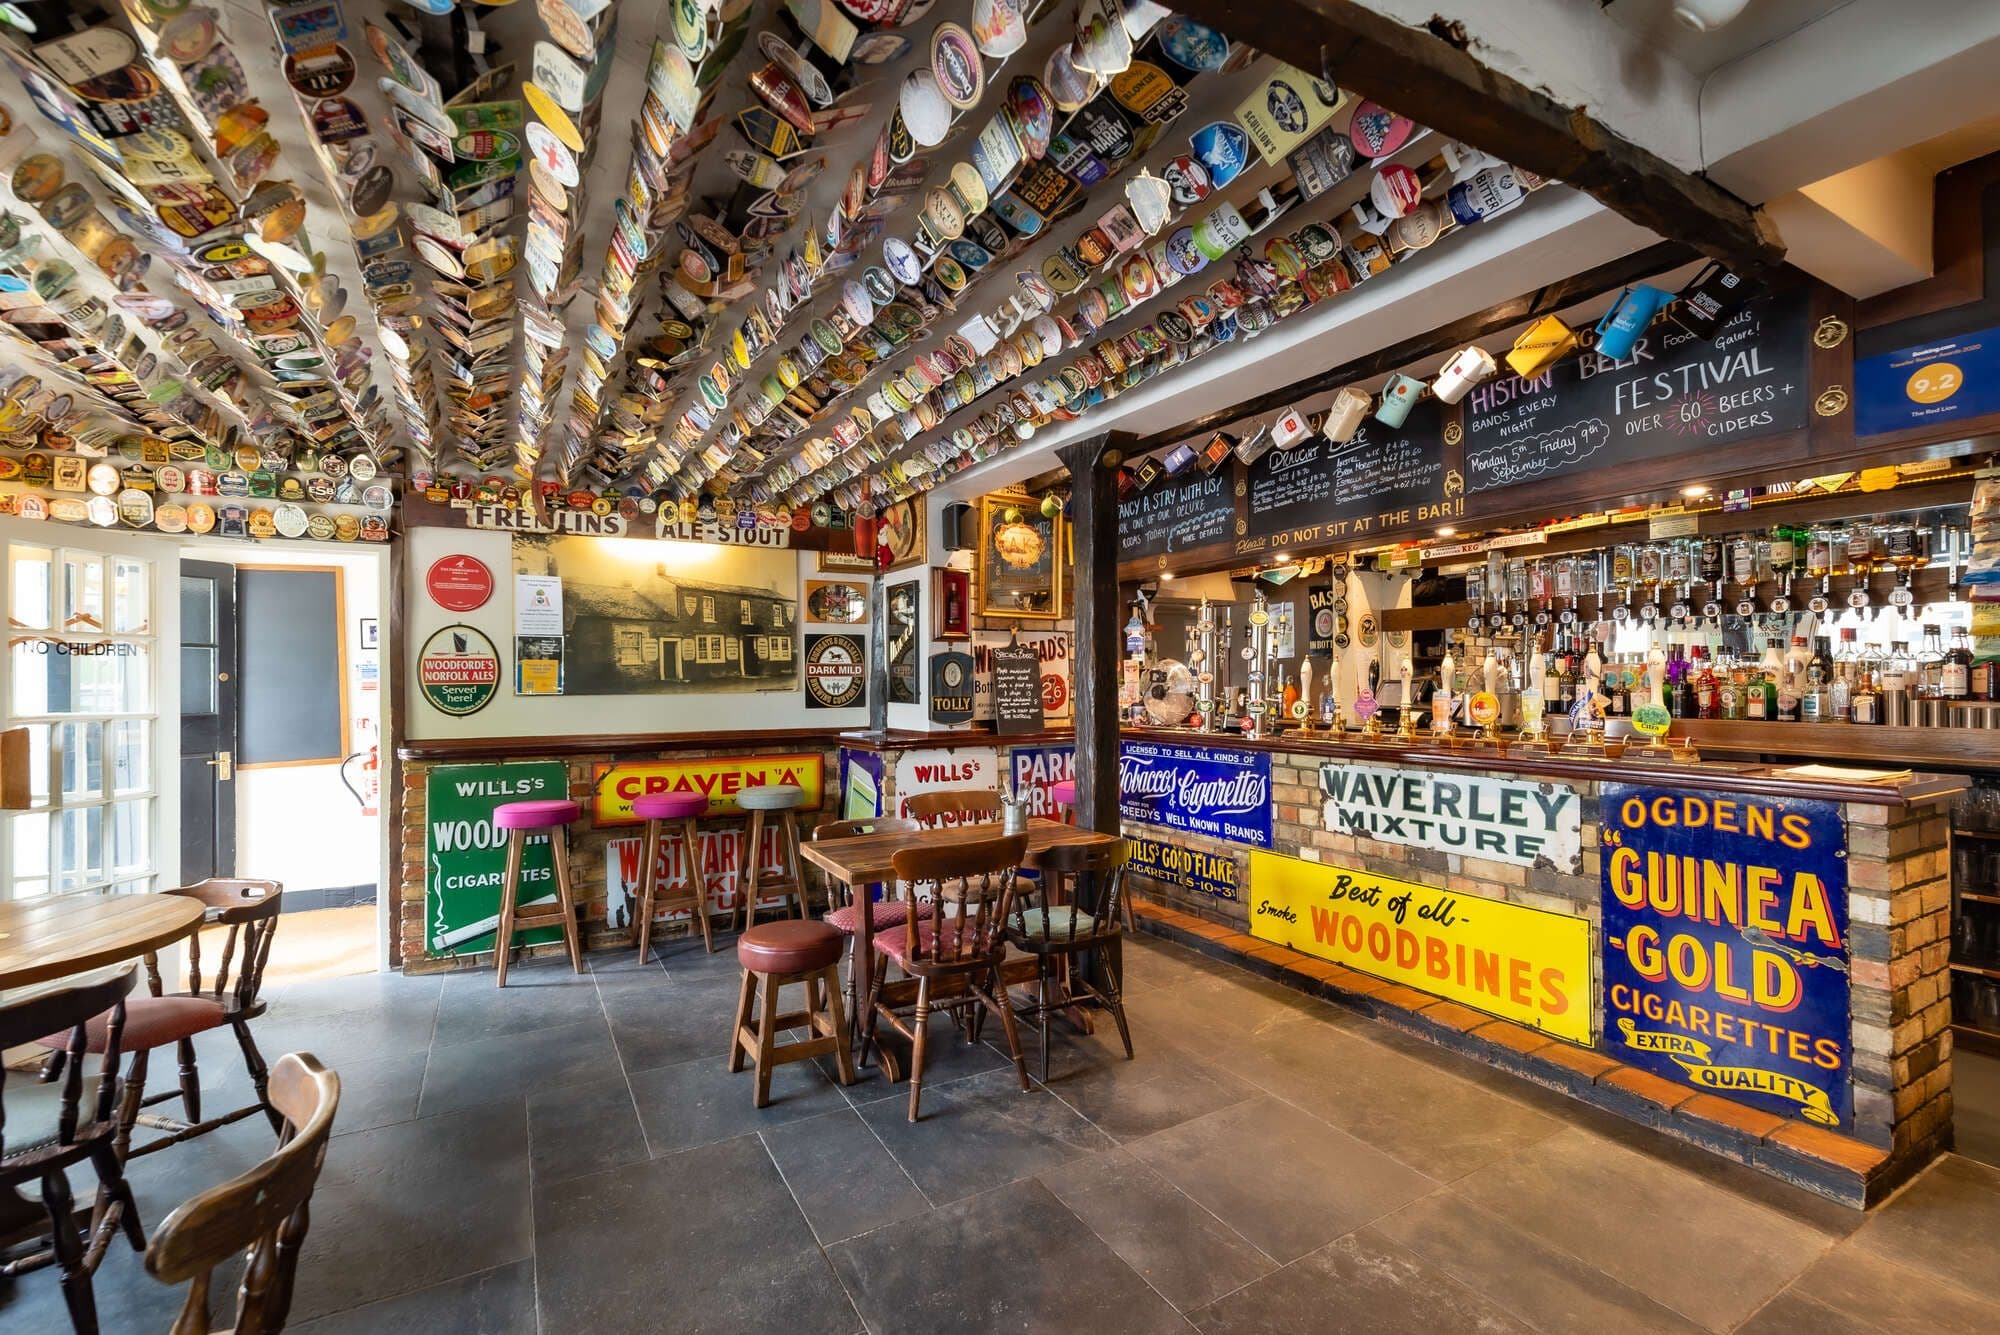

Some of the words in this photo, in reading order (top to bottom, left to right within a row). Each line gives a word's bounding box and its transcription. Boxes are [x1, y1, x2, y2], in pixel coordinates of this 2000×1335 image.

[309, 72, 341, 88] IPA
[1123, 71, 1158, 100] BLONDE
[1146, 90, 1184, 120] CLARK'S
[1091, 119, 1112, 136] BLACK
[1091, 119, 1128, 154] HARRY
[1244, 110, 1277, 155] SCULLION'S
[1025, 167, 1058, 202] BEER
[1295, 152, 1319, 192] MILD
[1476, 173, 1499, 211] BITTER
[1209, 211, 1224, 235] PALE
[1220, 233, 1237, 247] ALE
[1084, 234, 1107, 260] BEST
[1715, 321, 1761, 350] Galore!
[1100, 348, 1118, 375] ENIGMA
[1471, 370, 1552, 415] HISTON
[1579, 337, 1655, 382] BEER
[1615, 347, 1775, 416] FESTIVAL
[1914, 373, 1955, 394] 9.2
[1472, 410, 1510, 433] BANDS
[1518, 394, 1558, 417] EVERY
[1625, 414, 1663, 437] OVER
[1679, 402, 1702, 424] 60
[1719, 384, 1775, 414] BEERS
[1708, 409, 1774, 437] CIDERS
[1911, 410, 1925, 418] The
[1926, 408, 1940, 416] Red
[1941, 404, 1958, 413] Lion
[1500, 417, 1536, 437] NIGHT
[1471, 451, 1509, 473] Monday
[1511, 443, 1528, 461] 5th
[1539, 434, 1577, 456] Friday
[1581, 423, 1599, 444] 9th
[1490, 456, 1551, 482] September
[308, 485, 334, 495] ESB
[1118, 498, 1140, 519] ANCY
[1143, 496, 1150, 512] A
[1152, 487, 1177, 510] STAY
[1180, 480, 1202, 502] WITH
[1204, 476, 1224, 497] US?
[1132, 518, 1144, 530] ONE
[1147, 513, 1156, 525] OF
[1157, 508, 1170, 521] OUR
[1176, 499, 1206, 518] DELUXE
[1122, 535, 1142, 549] ROOMS
[1145, 526, 1169, 542] TODAY!
[1181, 533, 1196, 545] MORE
[1199, 525, 1224, 539] DETAILS
[1235, 537, 1267, 554] Please
[1272, 531, 1288, 547] DO
[1293, 527, 1321, 544] NOT
[1326, 521, 1348, 538] SIT
[1354, 516, 1372, 533] AT
[1379, 509, 1410, 527] THE
[1461, 543, 1479, 553] KEG
[1310, 591, 1333, 609] BAS
[22, 640, 50, 655] NO
[56, 640, 138, 657] CHILDREN
[424, 660, 494, 670] WOODFORDE'S
[425, 671, 470, 681] NORFOLK
[471, 671, 494, 681] ALES
[808, 665, 835, 674] DARK
[838, 664, 862, 675] MILD
[442, 685, 477, 694] Served
[447, 694, 473, 702] here!
[935, 697, 972, 712] TOLLY
[1640, 723, 1660, 731] Citra
[1016, 752, 1077, 784] PARK
[1126, 745, 1158, 756] LICENSED
[1162, 748, 1172, 757] TO
[1174, 749, 1192, 759] SELL
[1195, 751, 1210, 760] ALL
[1214, 753, 1239, 763] KINDS
[1243, 756, 1255, 764] OF
[616, 770, 767, 802] CRAVEN
[1120, 756, 1178, 799] Tobaccos
[1168, 793, 1176, 809] &
[1178, 769, 1266, 816] Cigarettes
[1322, 767, 1572, 833] WAVERLEY
[433, 818, 549, 853] WOOD
[1120, 803, 1161, 822] PREEDY'S
[1165, 812, 1187, 827] WELL
[1189, 816, 1220, 833] KNOWN
[1224, 822, 1267, 843] BRANDS.
[1338, 807, 1546, 860] MIXTURE
[446, 867, 551, 890] CIGARTES
[1194, 852, 1235, 885] FLAKE
[1257, 900, 1299, 925] Smoke
[1329, 874, 1380, 908] Best
[1387, 891, 1413, 925] of
[1310, 904, 1570, 1016] WOODBINES
[1610, 983, 1842, 1071] CIGARETTES
[1636, 1033, 1696, 1054] EXTRA
[1701, 1068, 1819, 1102] QUALITY
